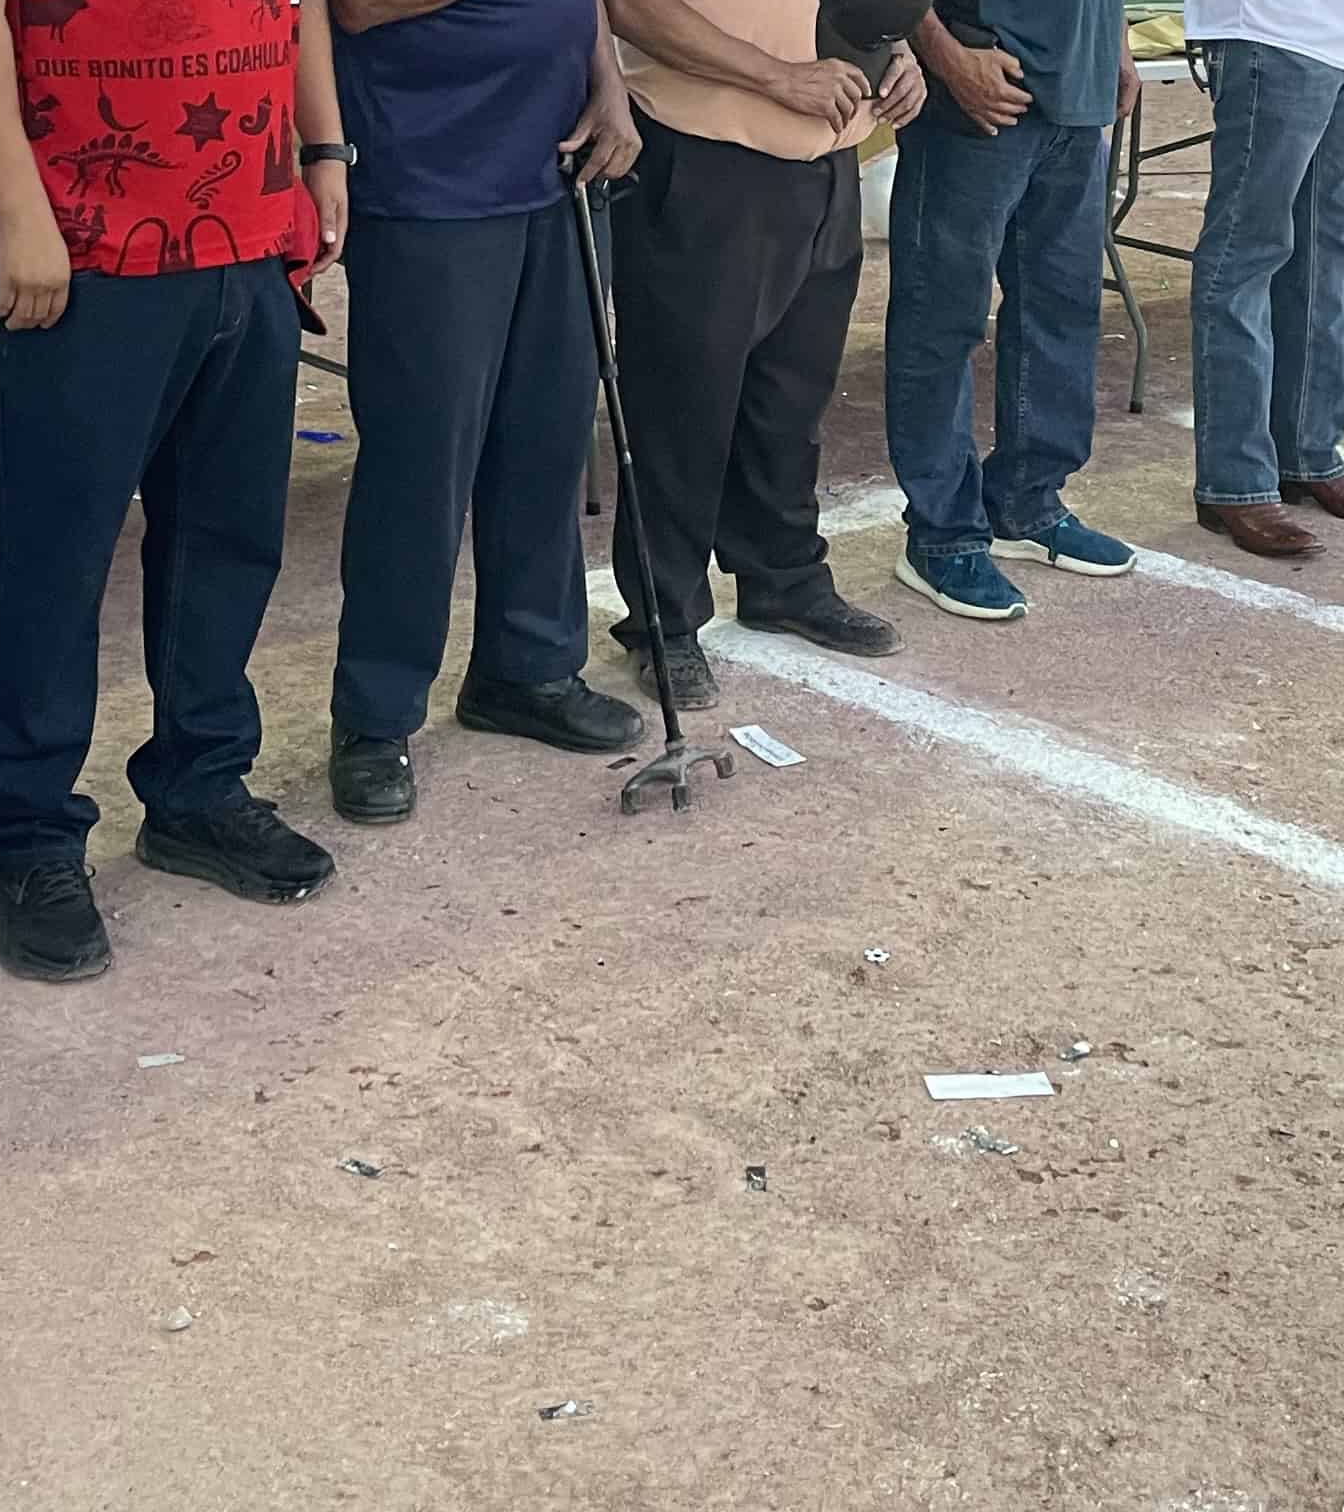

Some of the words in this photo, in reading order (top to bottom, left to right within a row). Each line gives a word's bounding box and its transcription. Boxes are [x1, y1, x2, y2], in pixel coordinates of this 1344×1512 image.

[35, 58, 81, 77] QUE
[87, 57, 175, 79] BONITO
[181, 54, 209, 78] ES
